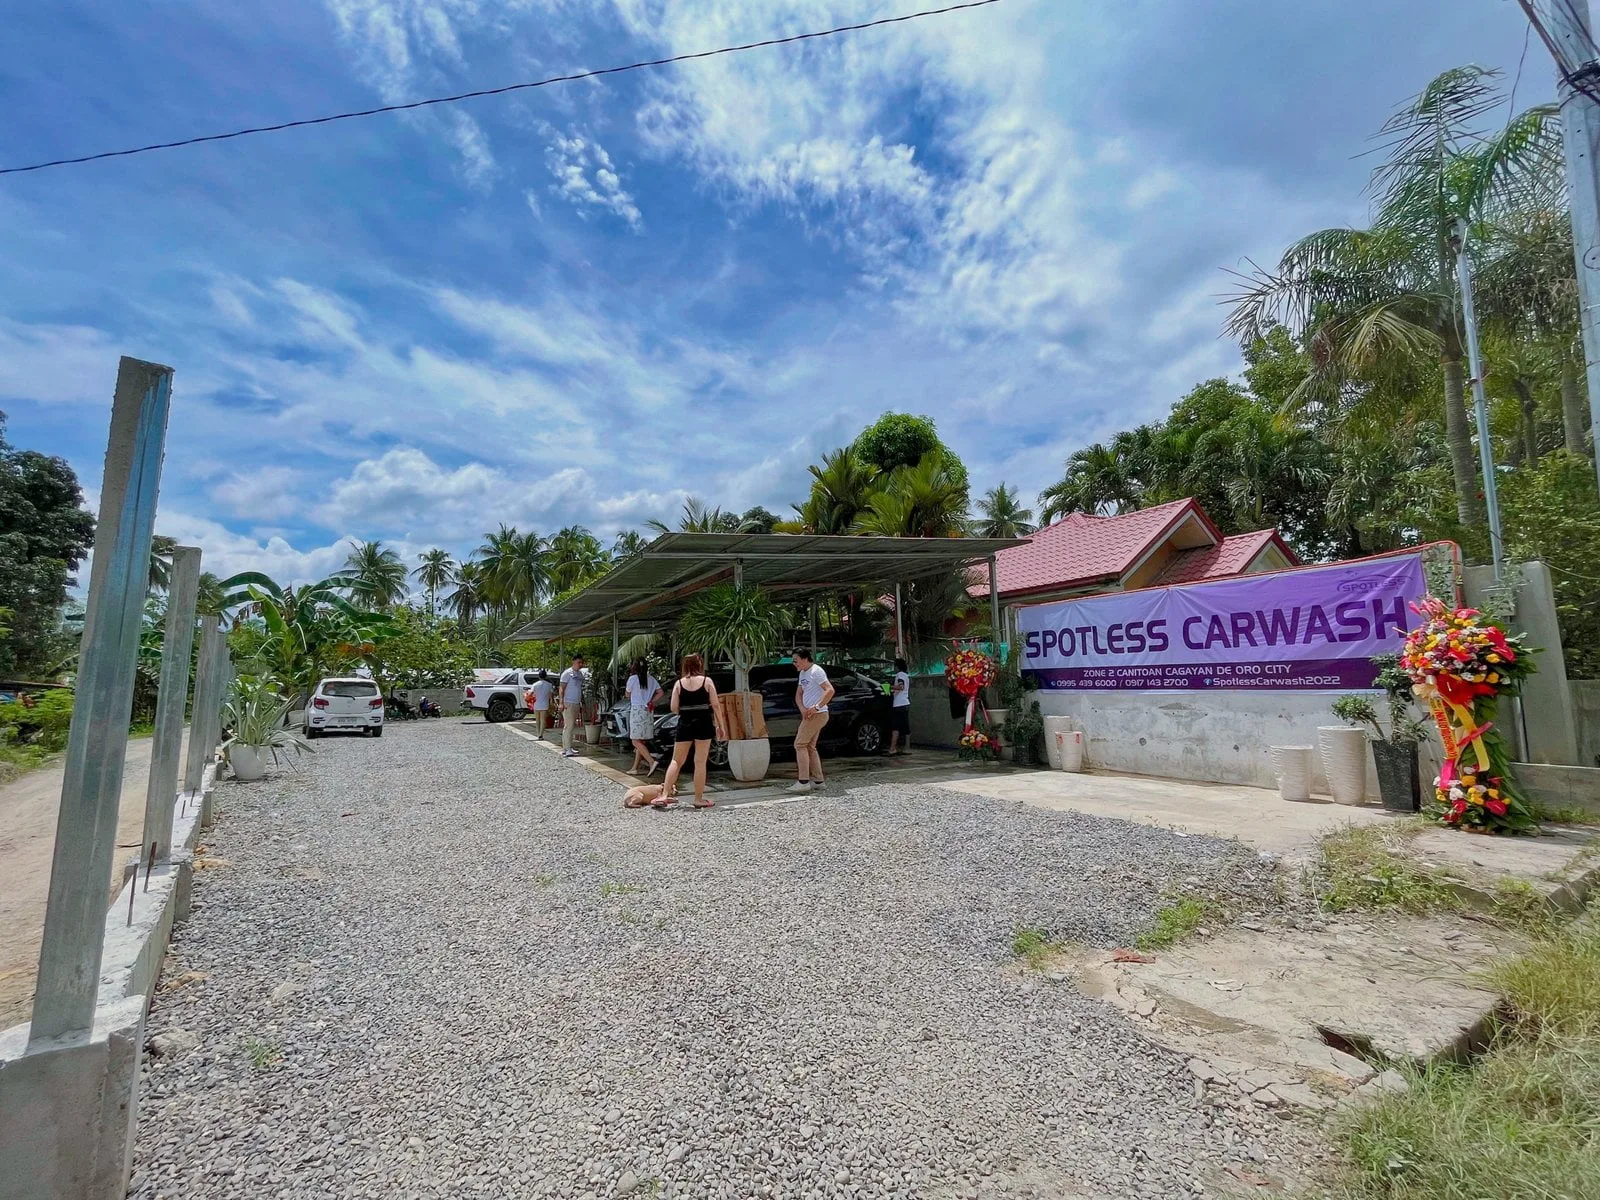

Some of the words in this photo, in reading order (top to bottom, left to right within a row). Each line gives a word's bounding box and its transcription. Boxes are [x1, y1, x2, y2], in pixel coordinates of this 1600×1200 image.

[1025, 619, 1170, 659] SPOTLESS
[1183, 596, 1408, 650] CARWASH
[1083, 669, 1106, 678] ZONE
[1108, 669, 1115, 677] 2
[1116, 668, 1162, 677] CANITOAN
[1165, 666, 1214, 676] CAGAYAN
[1216, 666, 1232, 675] DE
[1235, 665, 1261, 675] ORO
[1265, 664, 1292, 674] CITY
[1125, 679, 1144, 687] 0917
[1147, 679, 1161, 687] 143
[1163, 678, 1189, 687] 2700
[1213, 676, 1341, 687] SpotlessCarwash2022
